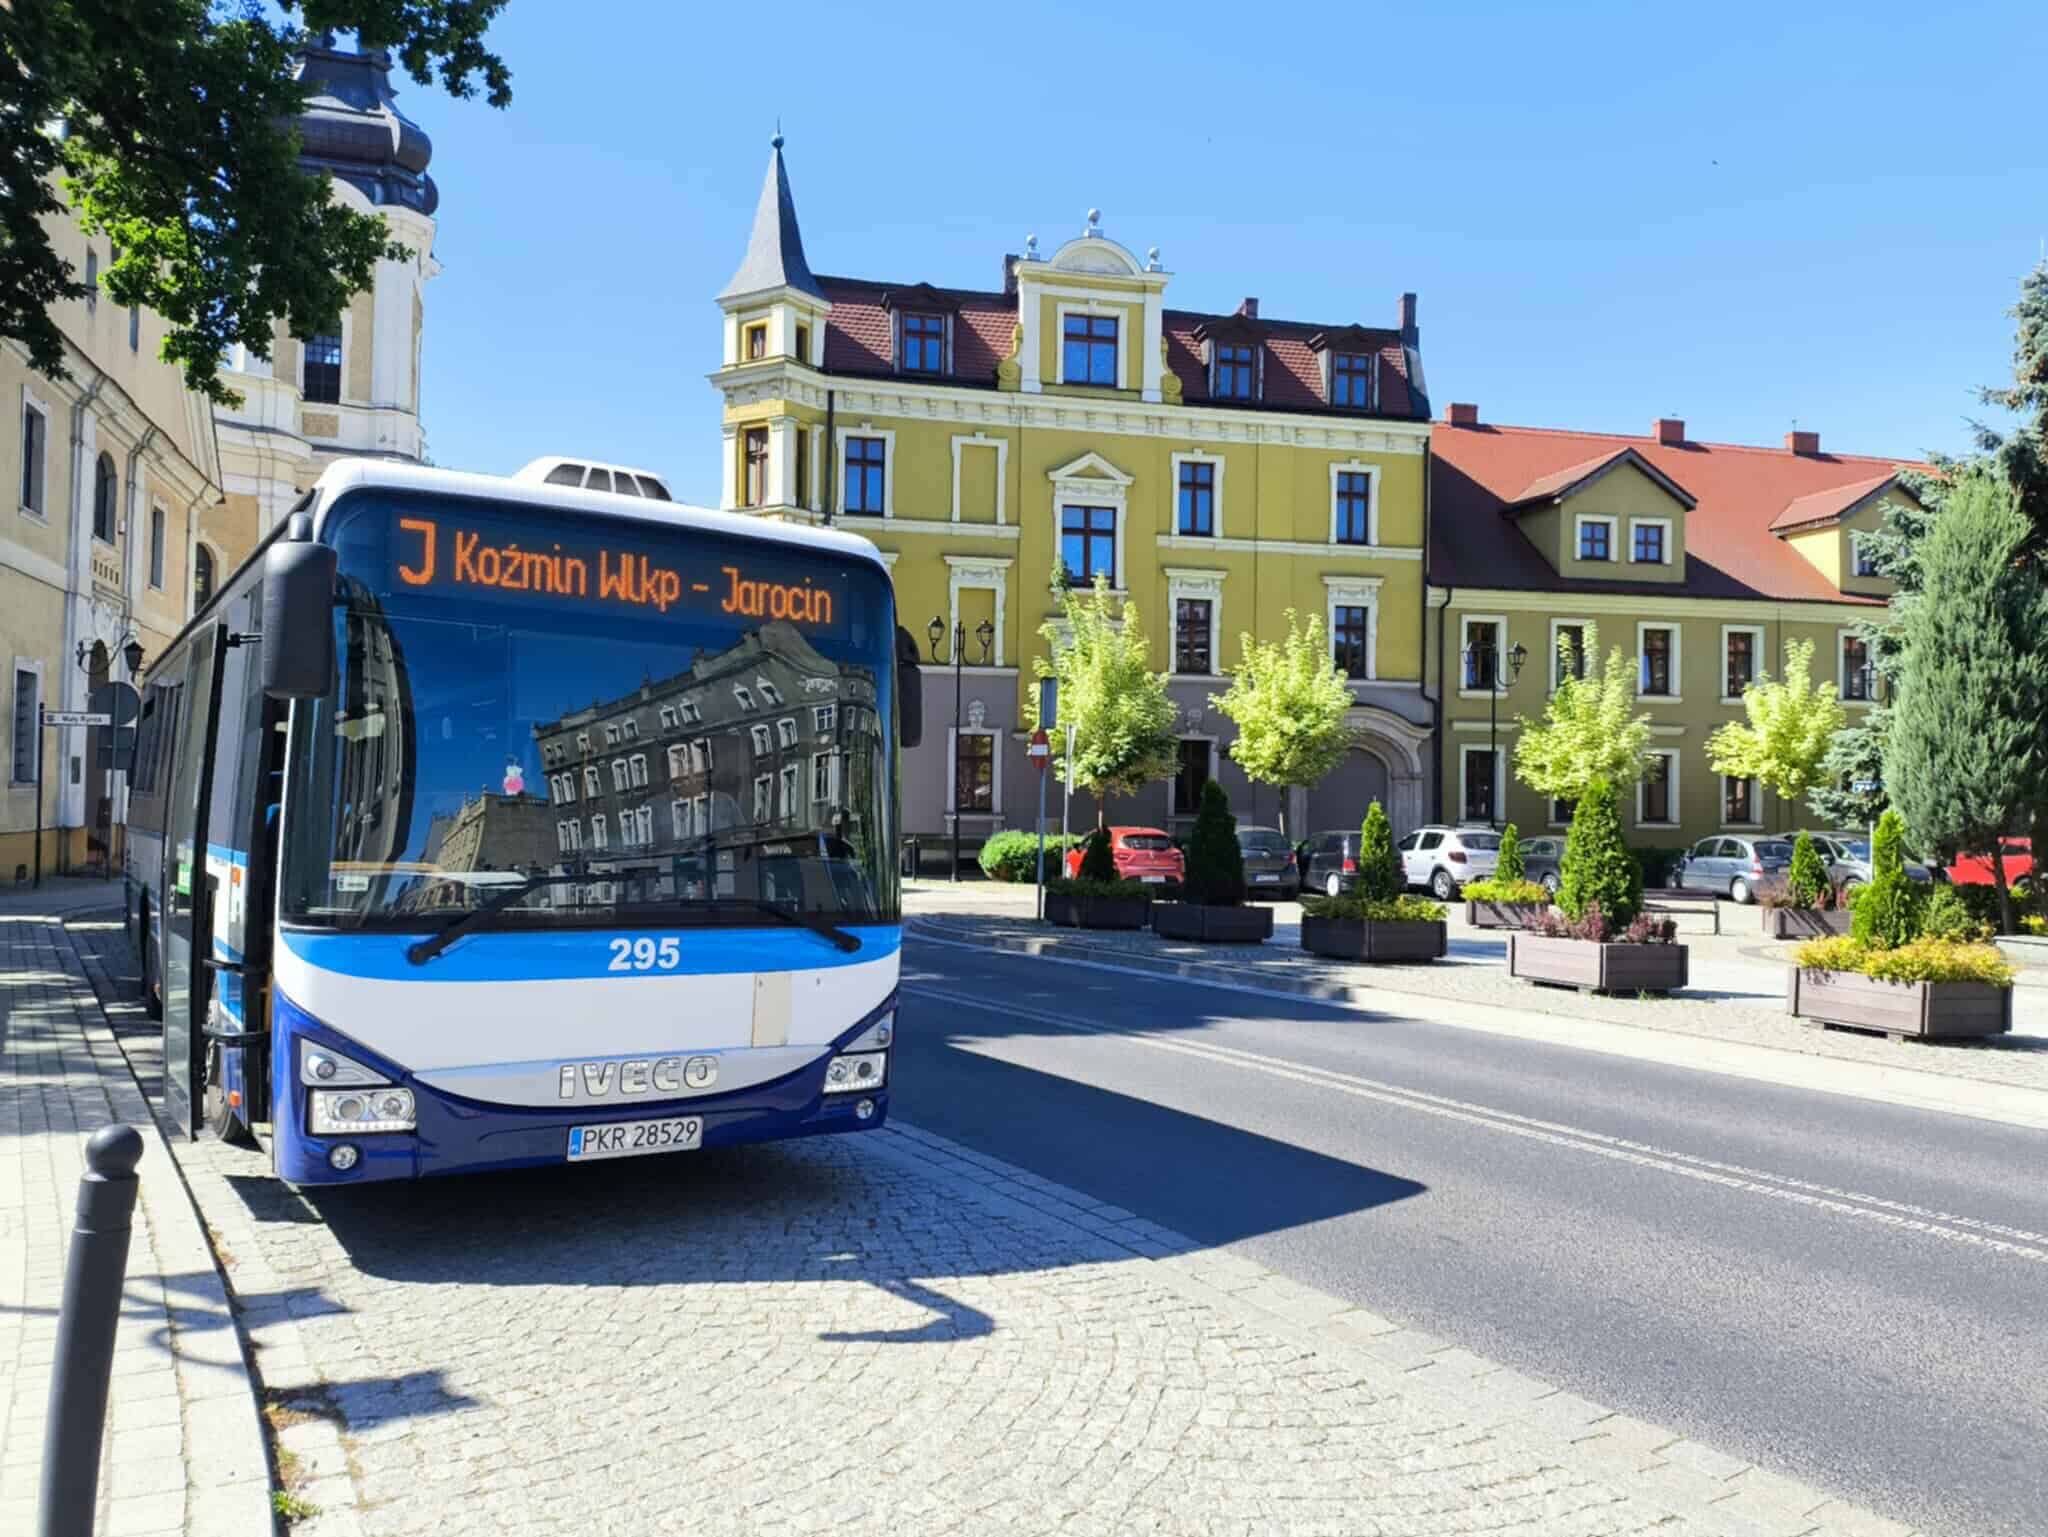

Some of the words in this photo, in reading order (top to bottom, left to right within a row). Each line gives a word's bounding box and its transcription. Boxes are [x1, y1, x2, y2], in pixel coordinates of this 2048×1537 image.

[399, 518, 435, 585] J
[455, 530, 587, 596] Koźmin
[600, 550, 680, 613] Wlkp
[721, 566, 832, 624] Jarocin
[608, 937, 681, 971] 295
[559, 1055, 720, 1099] IVECO
[582, 1127, 626, 1152] PKR
[632, 1120, 698, 1148] 28529
